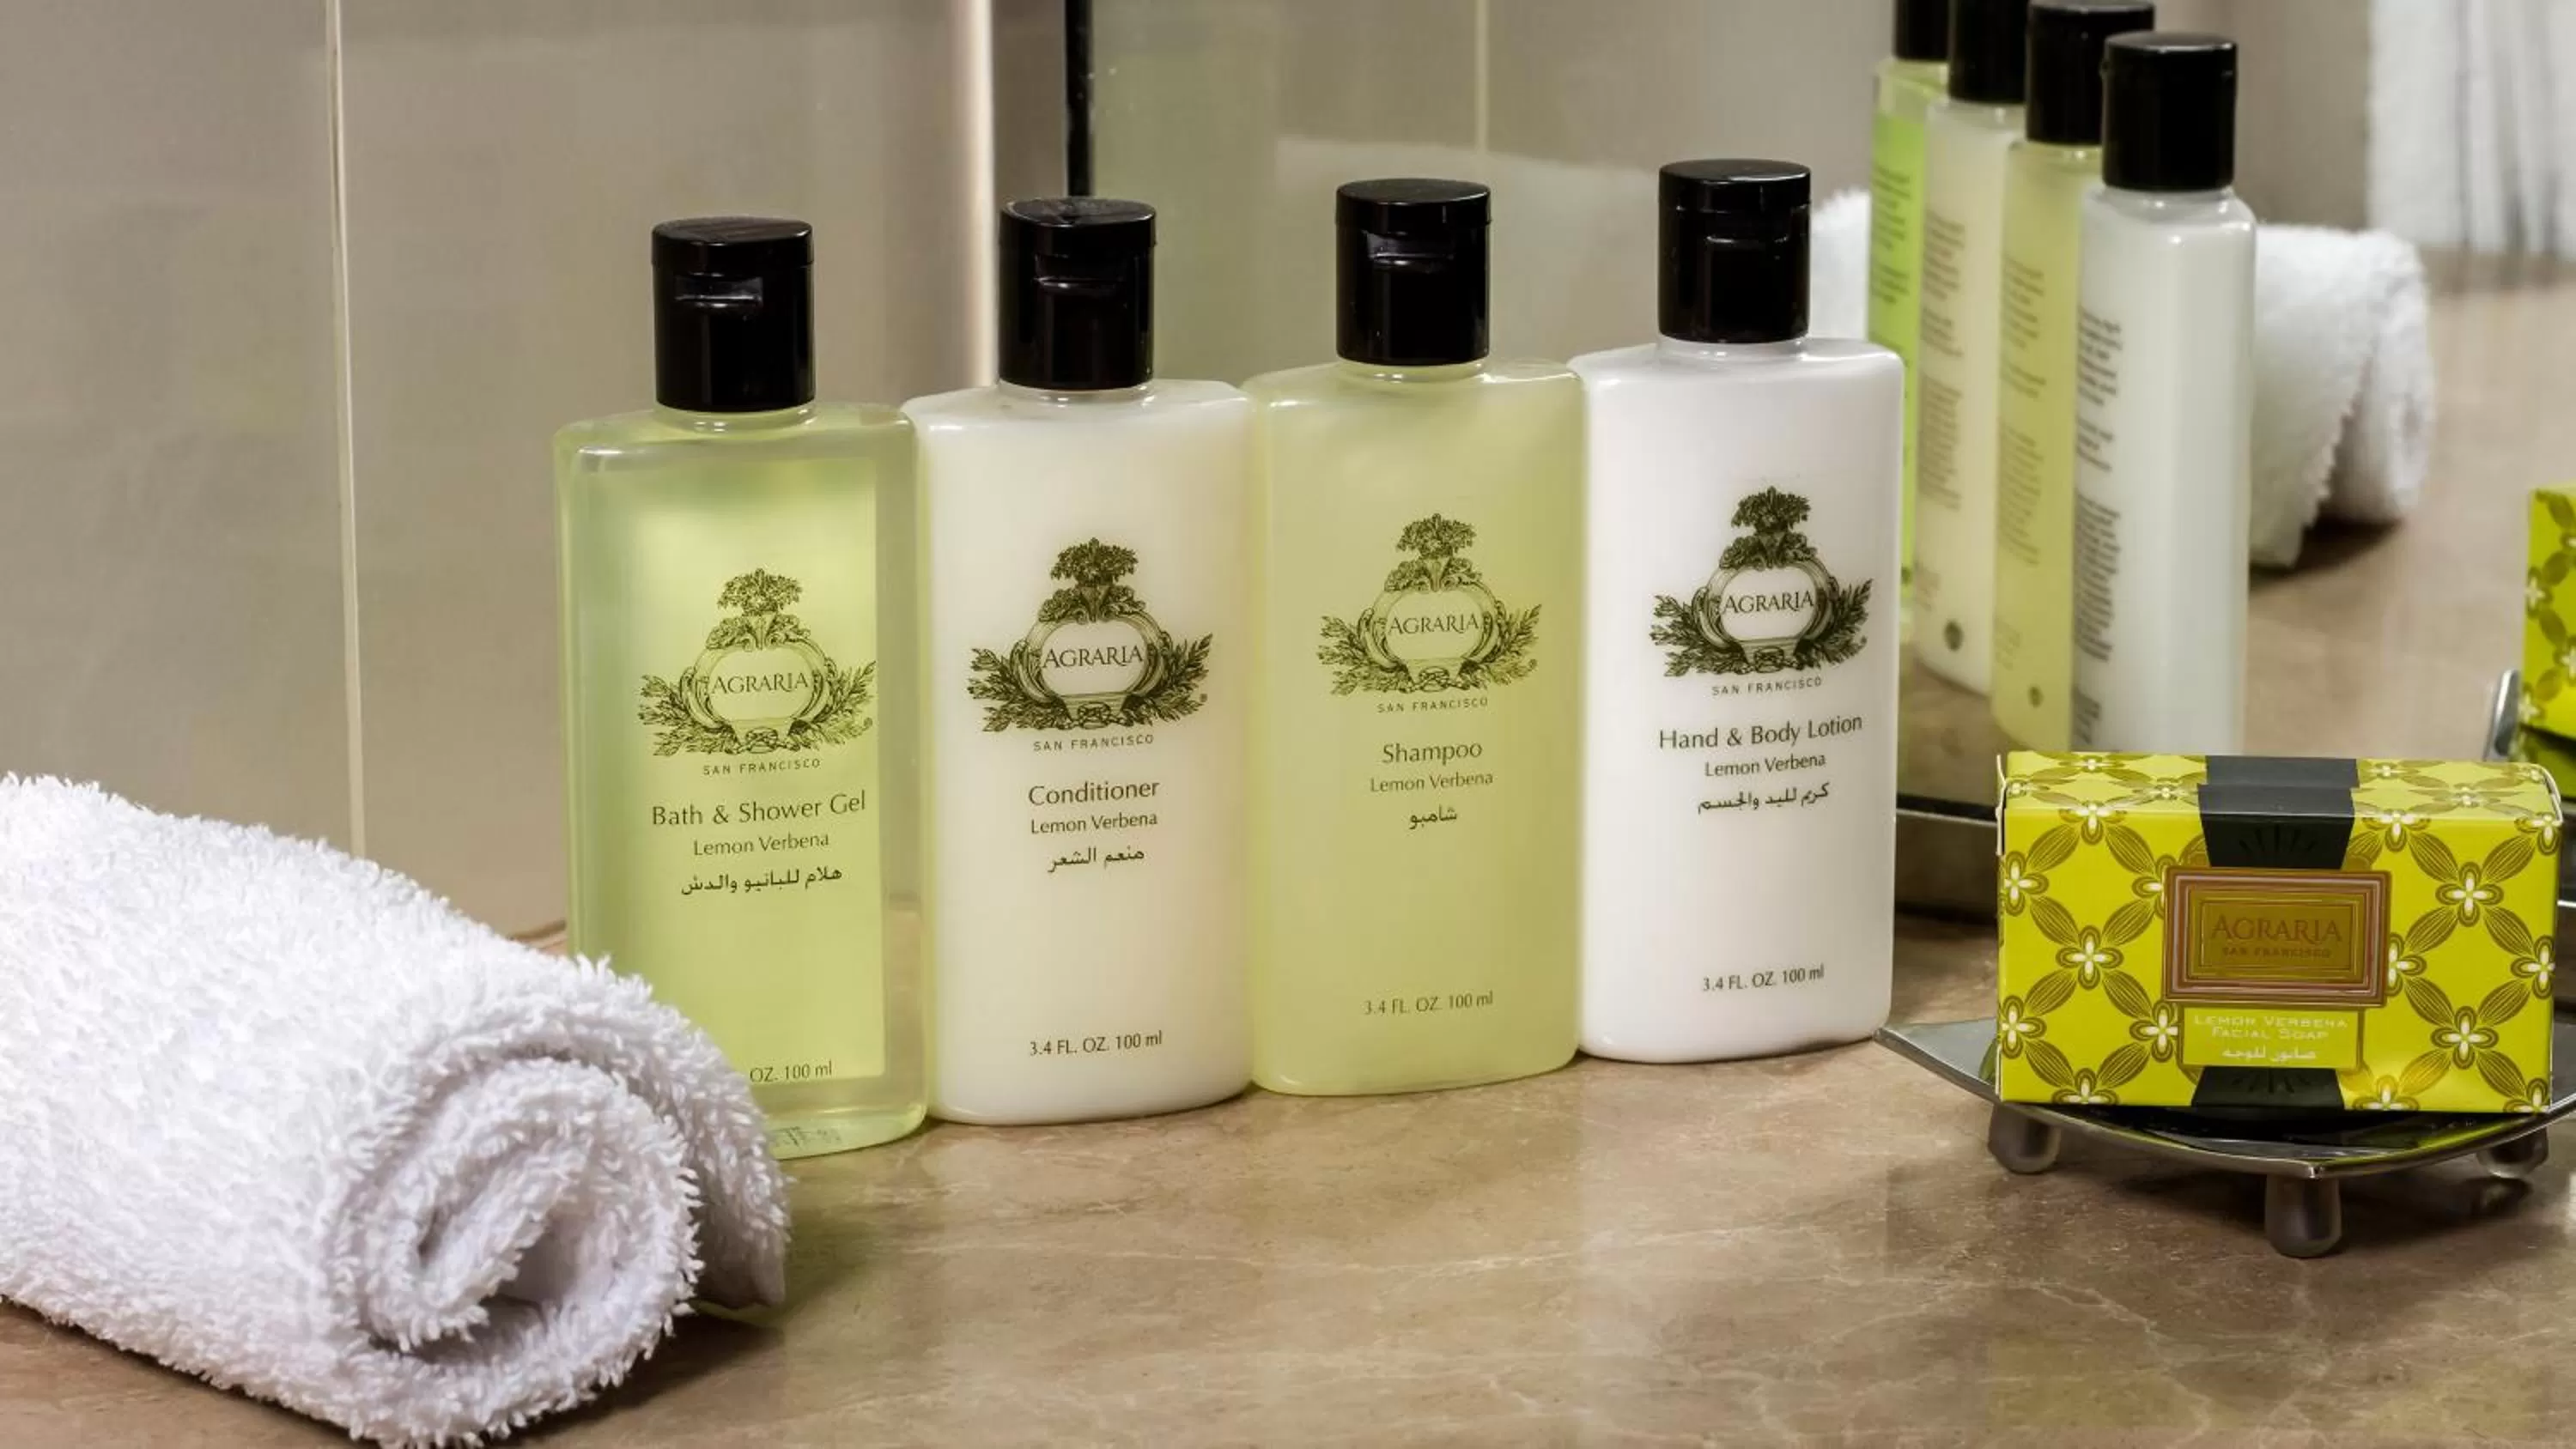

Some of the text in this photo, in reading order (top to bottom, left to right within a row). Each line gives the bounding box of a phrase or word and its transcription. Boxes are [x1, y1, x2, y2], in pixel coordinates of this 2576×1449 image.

[1721, 590, 1814, 615] AGRARIA
[1388, 613, 1480, 636] AGRARIA
[1042, 645, 1144, 669] AGRARIA
[710, 672, 810, 695] AGRARIA
[1711, 676, 1823, 696] SAN FRANCISCO
[1376, 697, 1488, 713] SAN FRANCISCO
[1033, 734, 1155, 752] SAN FRANCISCO
[1659, 715, 1863, 750] Hand & Body Lotion
[1382, 740, 1484, 766] Shampoo
[1704, 753, 1826, 777] Lemon Verbena
[702, 758, 821, 776] SAN FRANCISCO
[1029, 778, 1160, 806] Conditioner
[1370, 771, 1493, 792] Lemon Verbena
[652, 789, 866, 827] Bath & Shower Gel
[1698, 791, 1759, 814] والجسم
[1765, 787, 1798, 808] لليد
[1030, 810, 1158, 834] Lemon Verbena
[1409, 803, 1458, 829] شامبو
[693, 833, 829, 856] Lemon Verbena
[1047, 845, 1145, 873] منعم الشعر
[681, 866, 842, 894] هلام للبانيو والدش
[1703, 976, 1724, 992] 3.4
[1728, 974, 1748, 990] FL.
[1783, 967, 1806, 984] 100
[1808, 962, 1825, 980] ml
[1364, 1000, 1387, 1015] 3.4
[1449, 992, 1473, 1009] 100
[1476, 990, 1493, 1007] ml
[1030, 1040, 1052, 1057] 3.4
[1057, 1040, 1078, 1055] FL.
[1115, 1033, 1141, 1050] 100
[1145, 1029, 1162, 1047] ml
[750, 1058, 832, 1082] OZ. 100 ml
